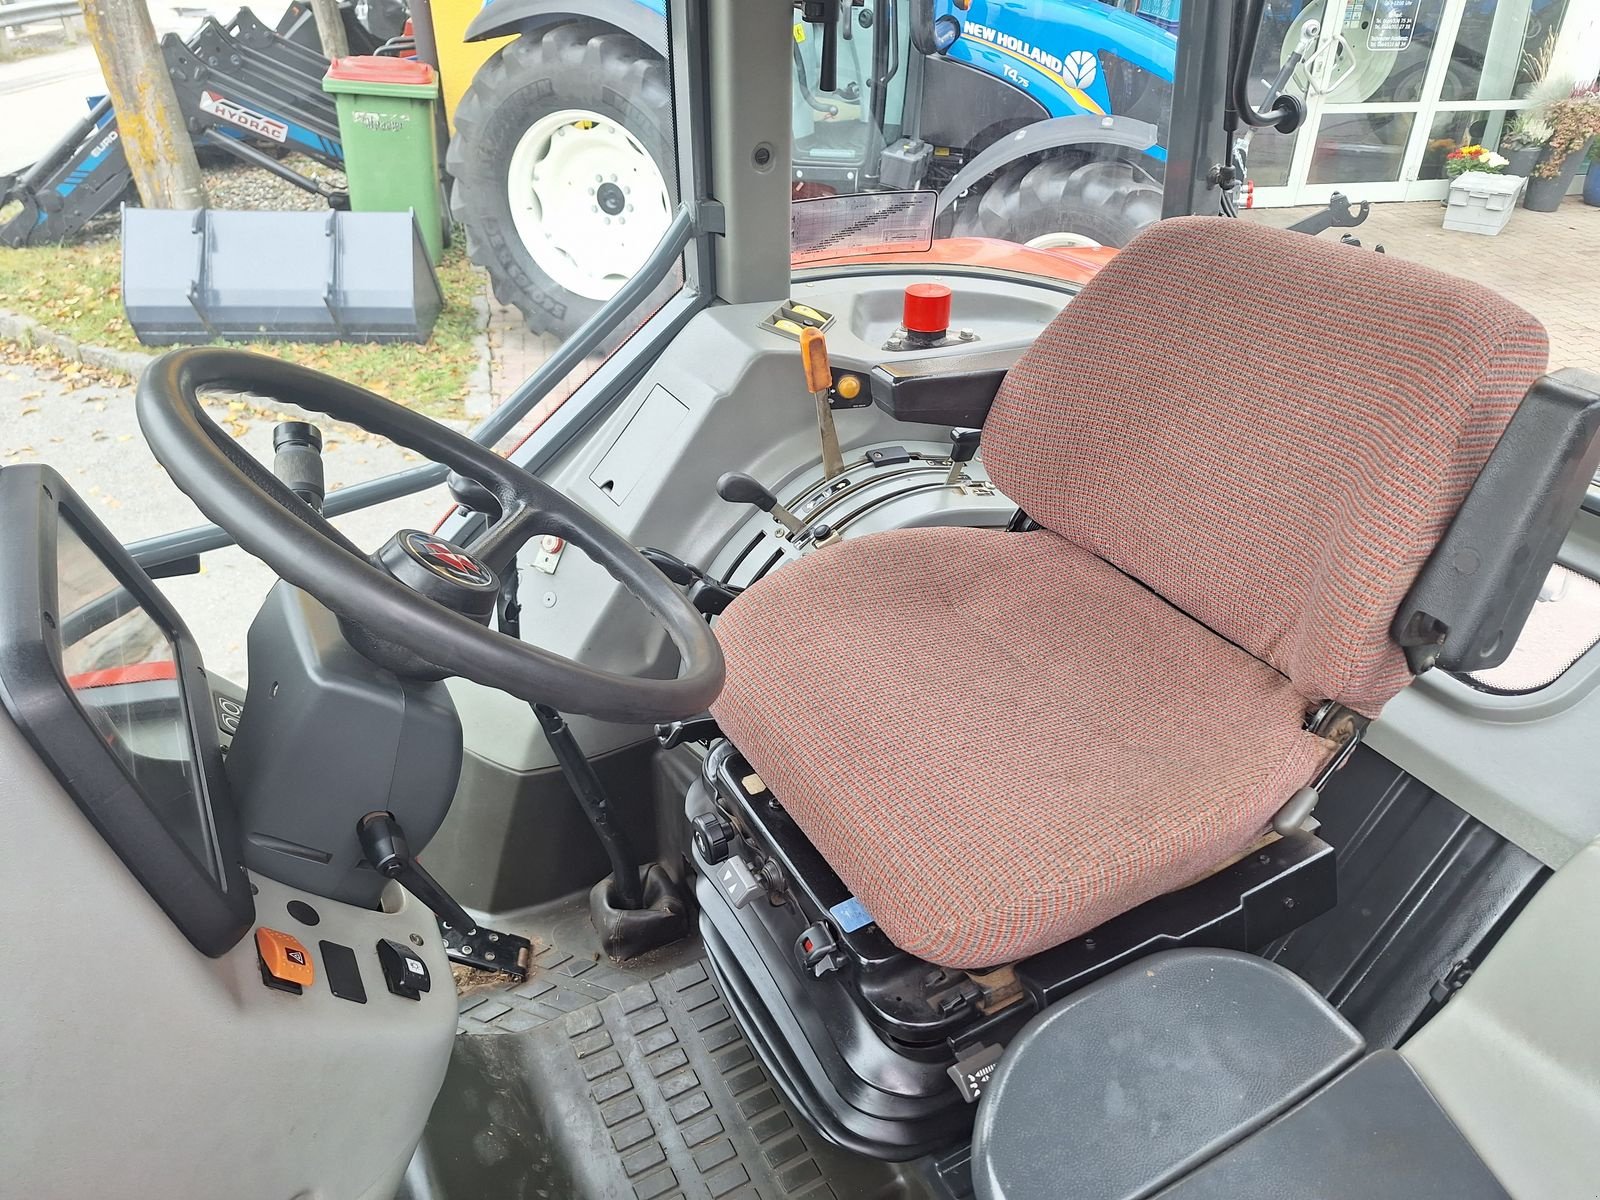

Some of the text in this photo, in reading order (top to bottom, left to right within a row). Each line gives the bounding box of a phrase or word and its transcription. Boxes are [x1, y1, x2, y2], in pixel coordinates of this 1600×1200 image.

[964, 21, 1063, 73] NEW HOLLAND
[215, 105, 282, 138] HYDRAC
[90, 130, 119, 158] EURO
